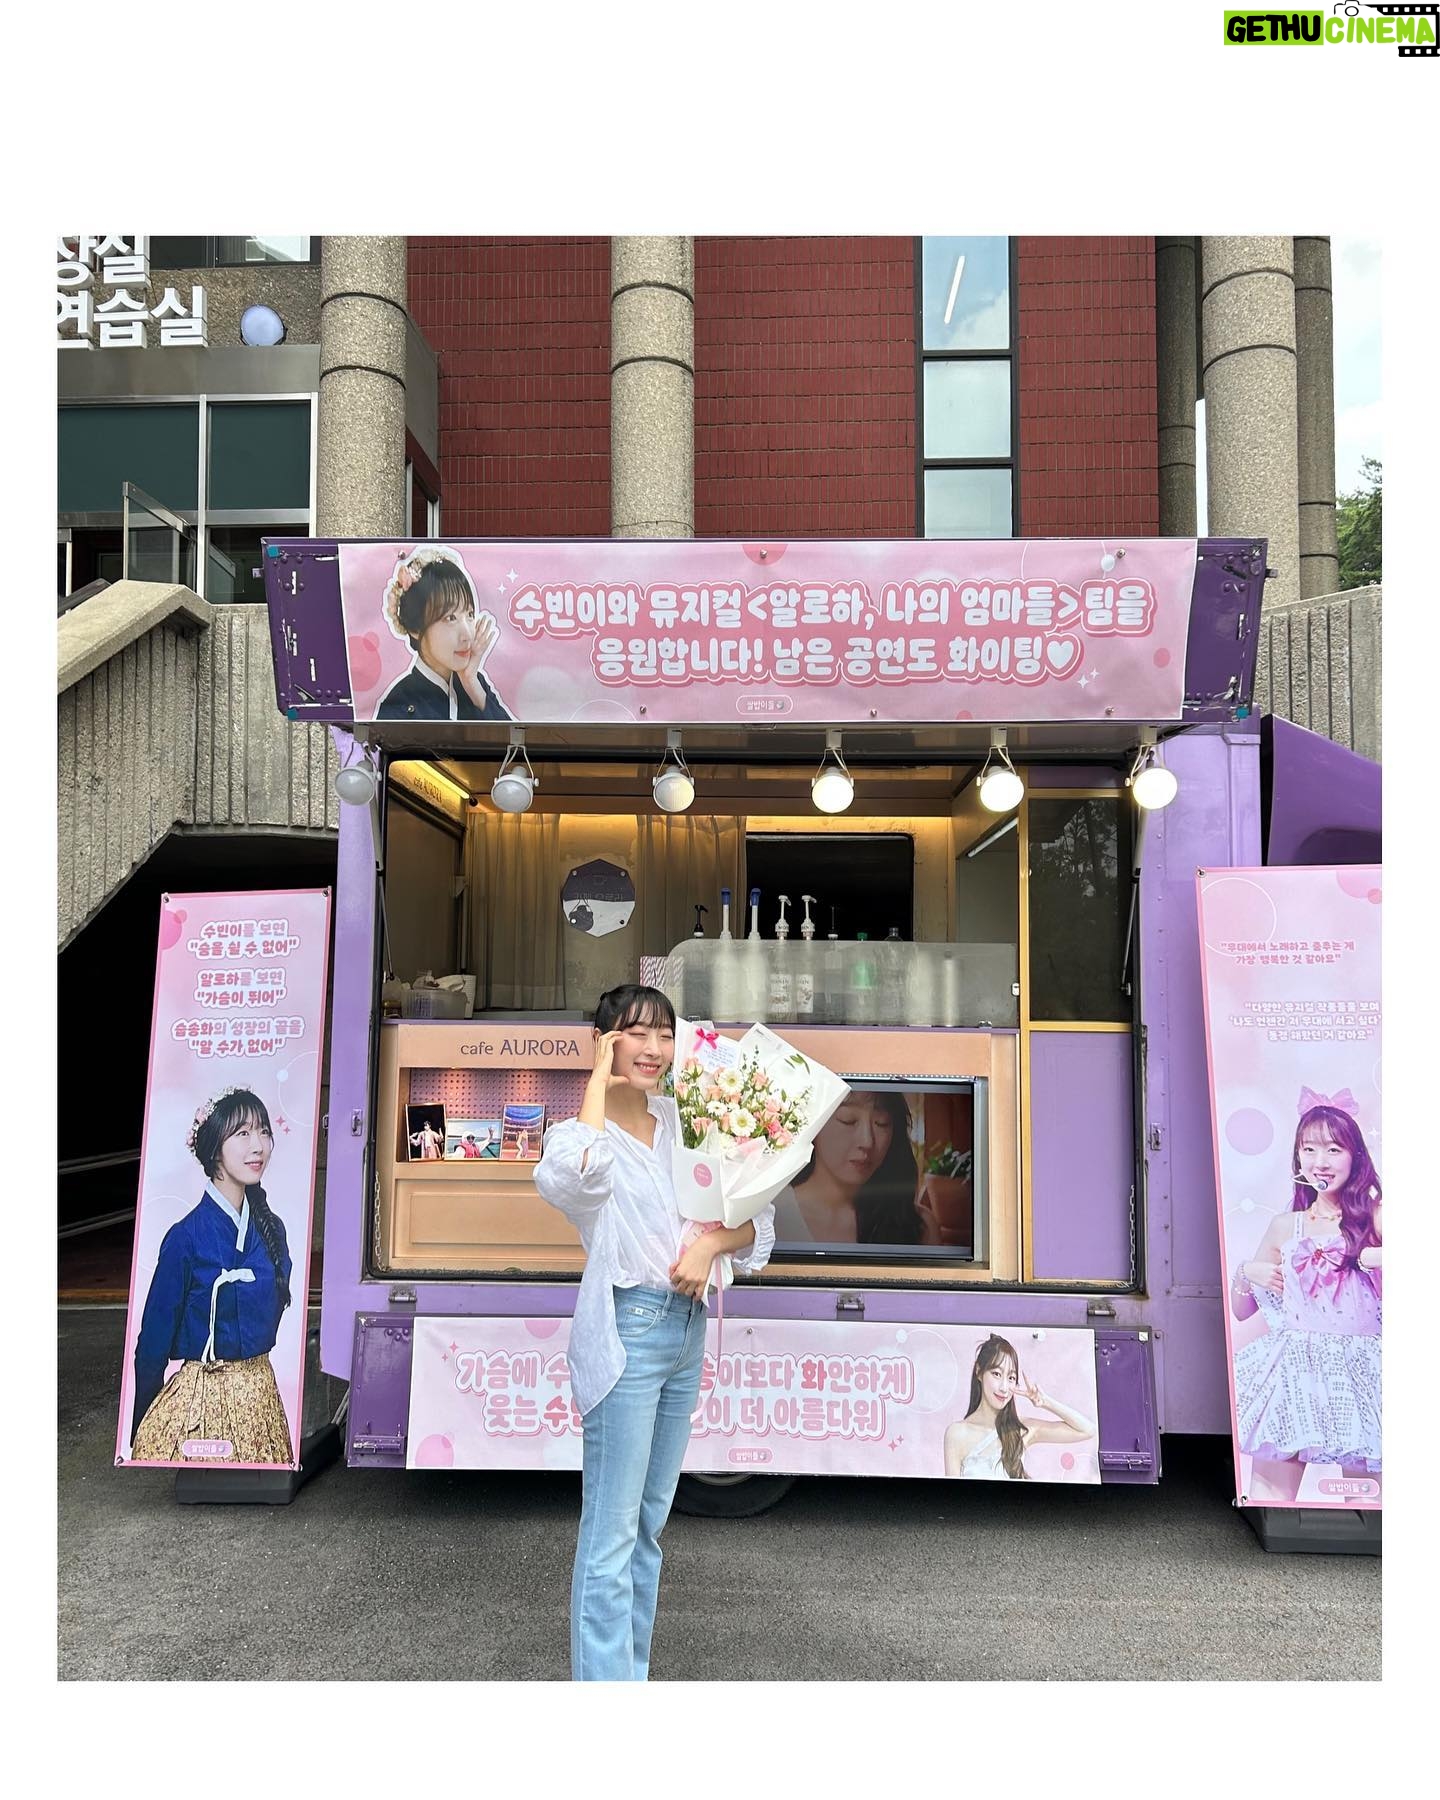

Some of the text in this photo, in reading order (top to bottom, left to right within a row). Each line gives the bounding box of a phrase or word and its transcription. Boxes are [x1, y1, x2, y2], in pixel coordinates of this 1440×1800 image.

[514, 589, 640, 628] 수빈이와
[886, 587, 950, 625] 나의
[596, 637, 763, 676] 응원합니다!
[773, 637, 834, 676] 남은
[845, 637, 938, 676] 공연도
[203, 922, 285, 938] 수빈이를 보면
[228, 941, 240, 955] 쉴
[245, 941, 257, 955] 수
[262, 939, 297, 954] 없어"
[200, 971, 283, 987] 알로하를 보면
[197, 991, 243, 1006] "가슴이
[231, 1020, 271, 1036] 성장의
[217, 1039, 243, 1054] 수가
[247, 1037, 283, 1053] 없어"
[460, 1039, 580, 1057] cafe AURORA
[460, 1356, 538, 1389] 가슴에
[801, 1358, 907, 1394] 화안하게
[487, 1394, 538, 1428] 웃는
[740, 1395, 764, 1428] 더
[773, 1396, 879, 1432] 아름다워
